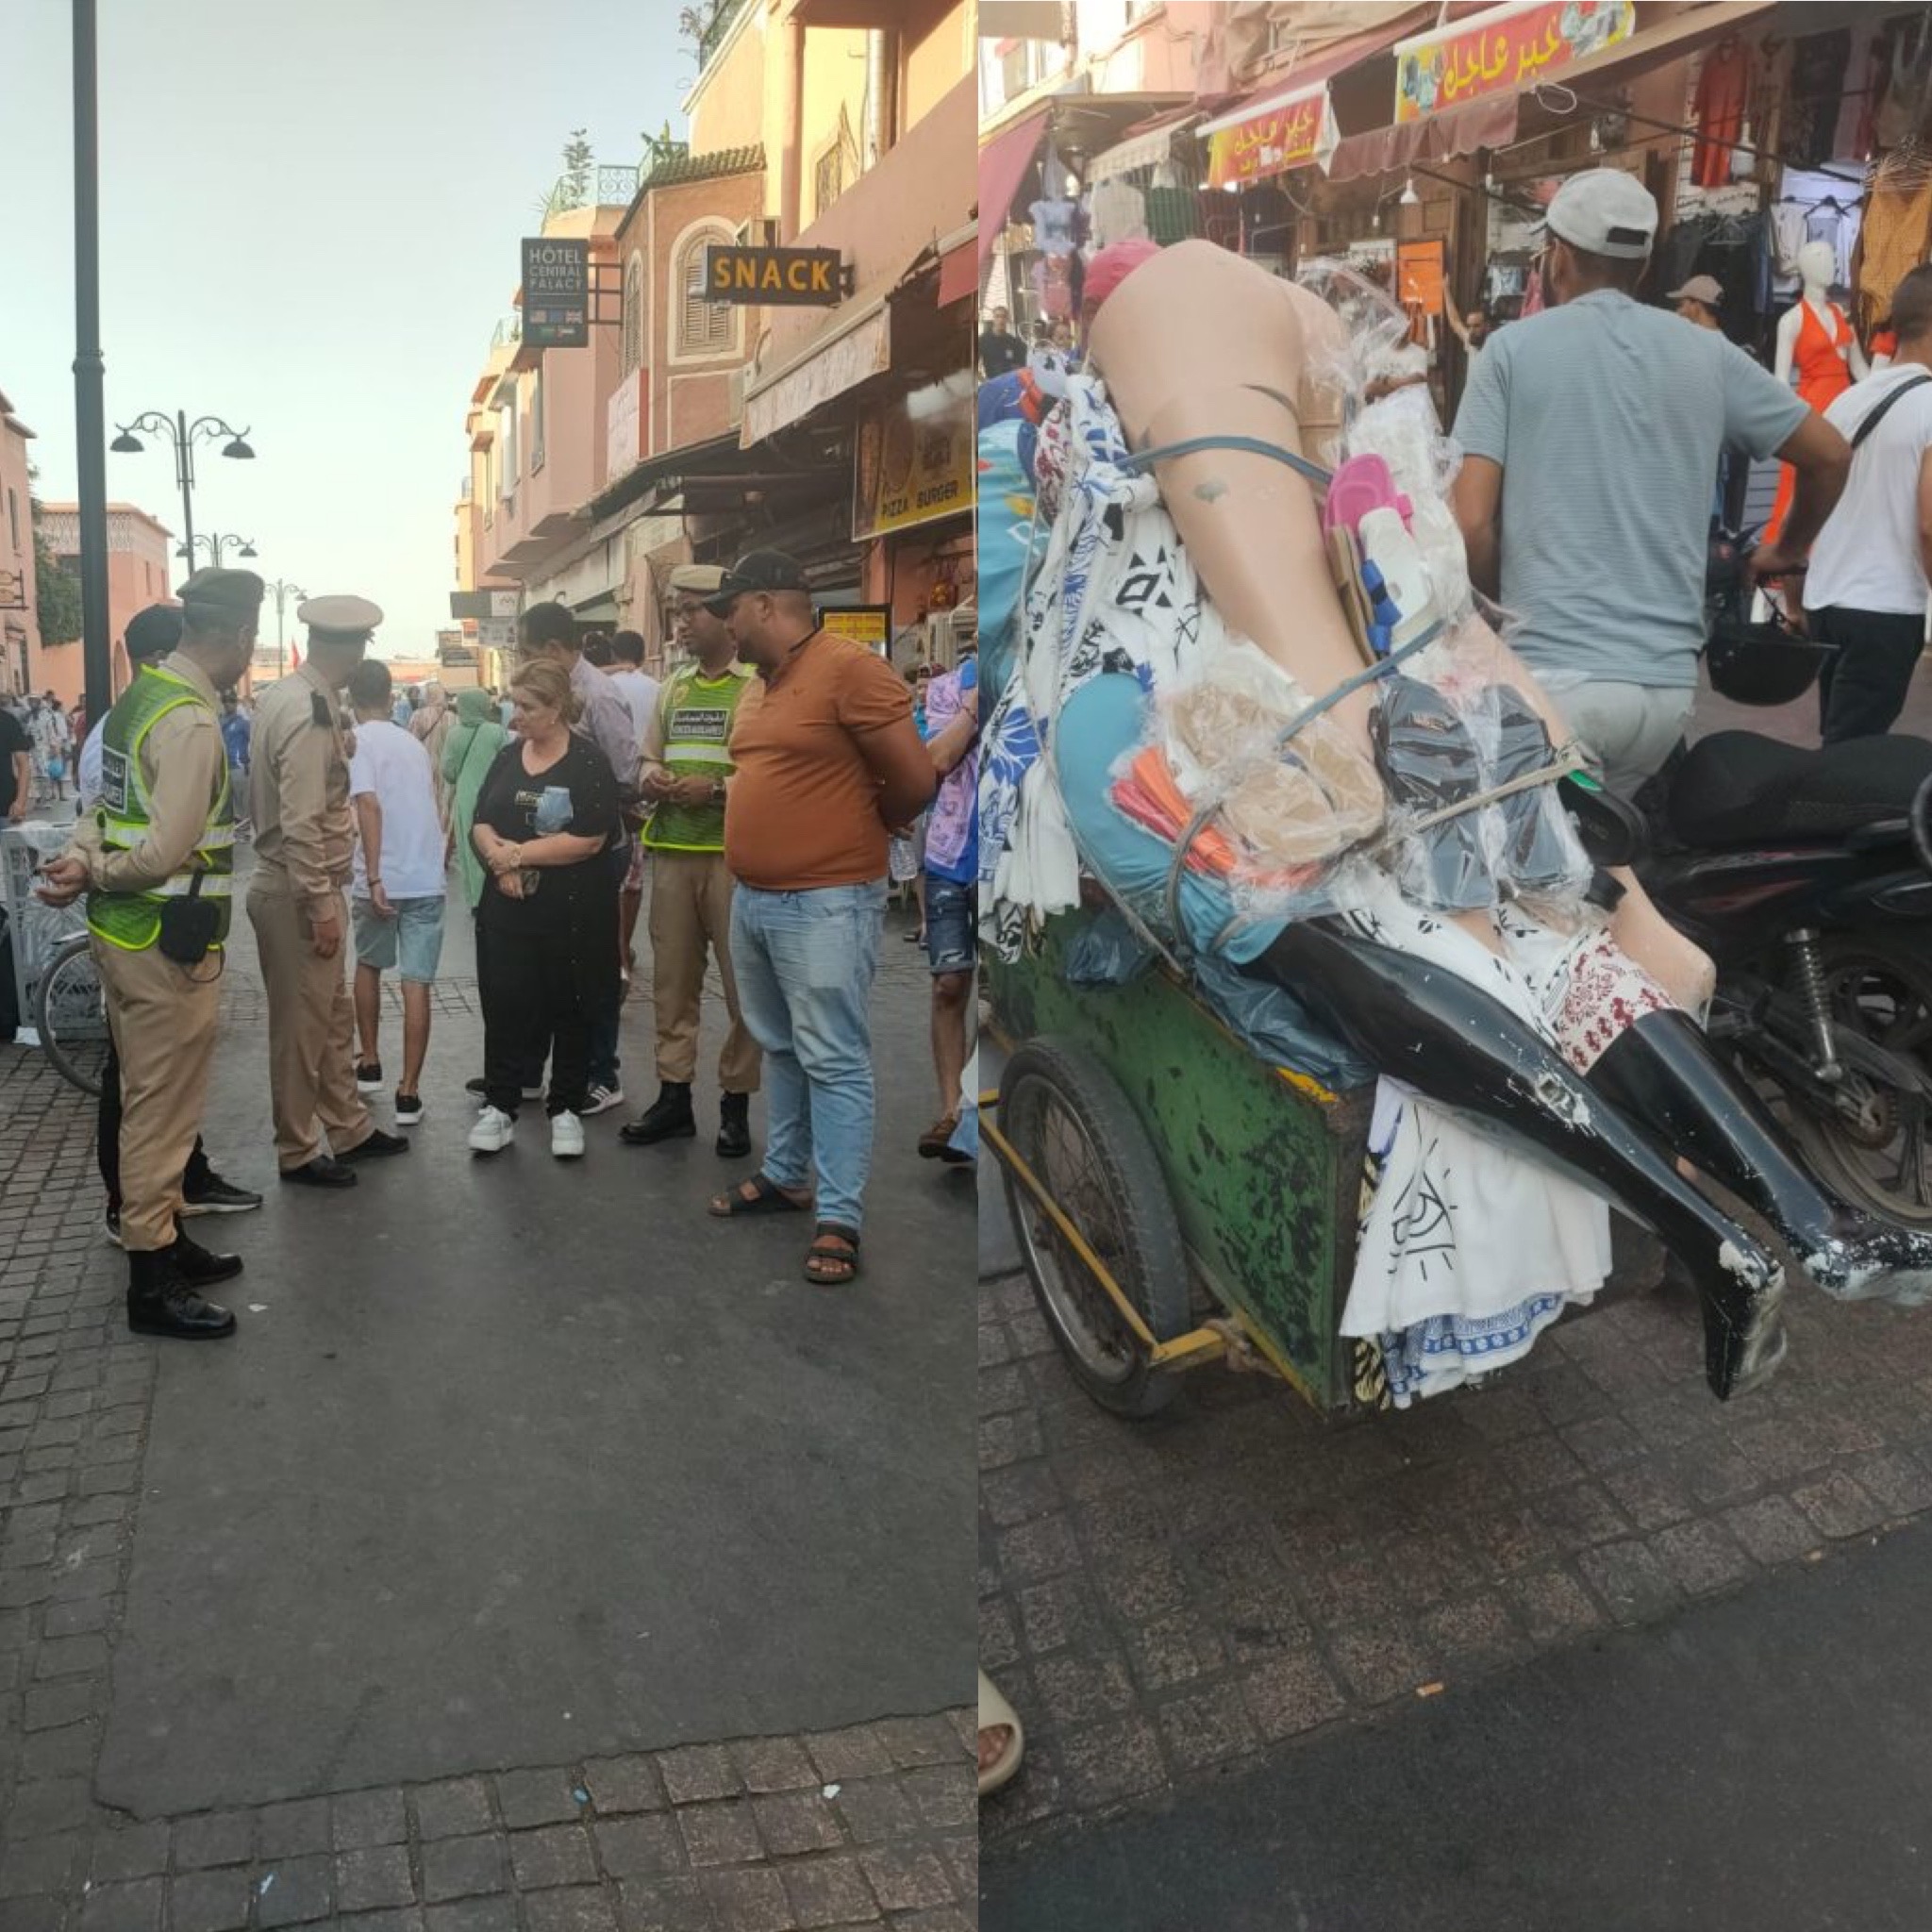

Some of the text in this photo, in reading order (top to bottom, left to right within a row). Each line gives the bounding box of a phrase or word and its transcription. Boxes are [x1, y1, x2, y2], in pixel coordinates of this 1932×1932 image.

[1443, 30, 1508, 100] عاجل
[529, 245, 582, 264] HÔTEL
[529, 265, 582, 278] CENTRAL
[713, 256, 830, 291] SNACK
[916, 478, 959, 510] BURGER
